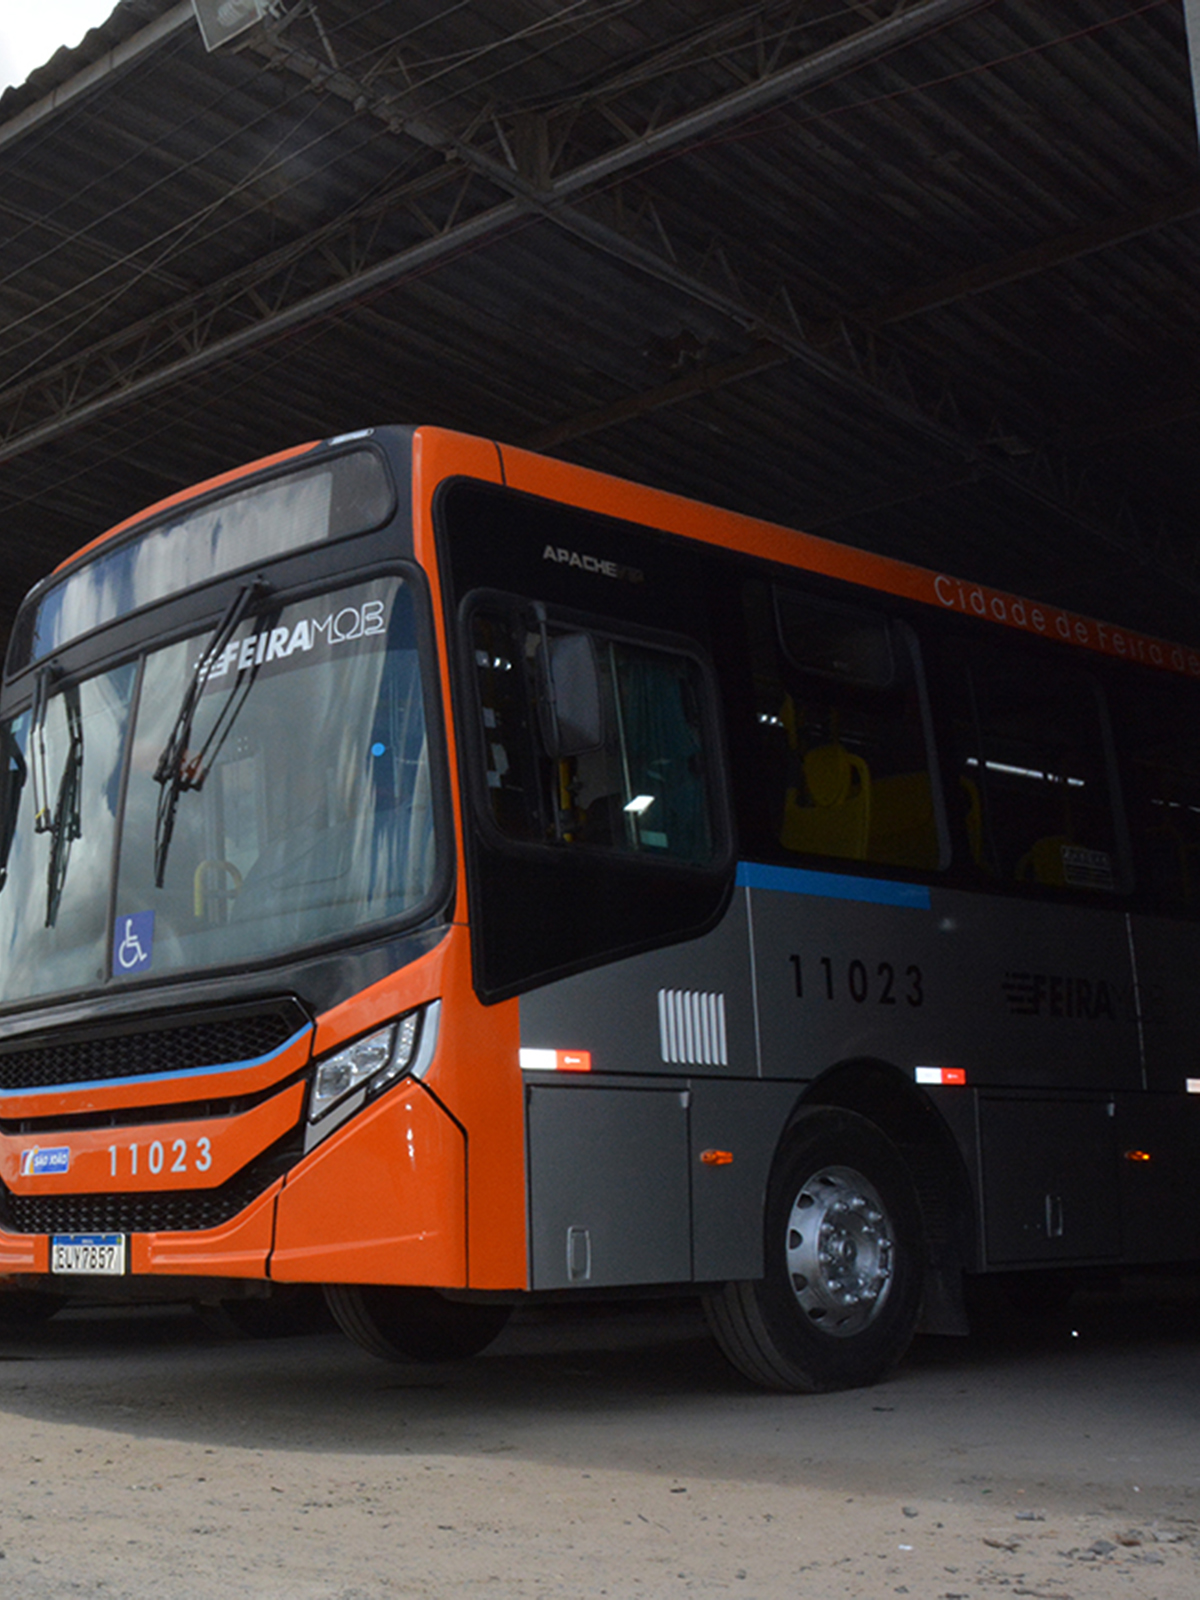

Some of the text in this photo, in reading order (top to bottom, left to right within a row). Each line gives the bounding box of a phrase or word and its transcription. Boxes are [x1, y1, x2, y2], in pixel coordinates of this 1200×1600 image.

[542, 544, 618, 579] APACHE
[933, 575, 1047, 632] Cidade
[1055, 611, 1090, 643] de
[1096, 622, 1164, 664] Feira
[790, 955, 923, 1007] 11023
[108, 1136, 212, 1176] 11023
